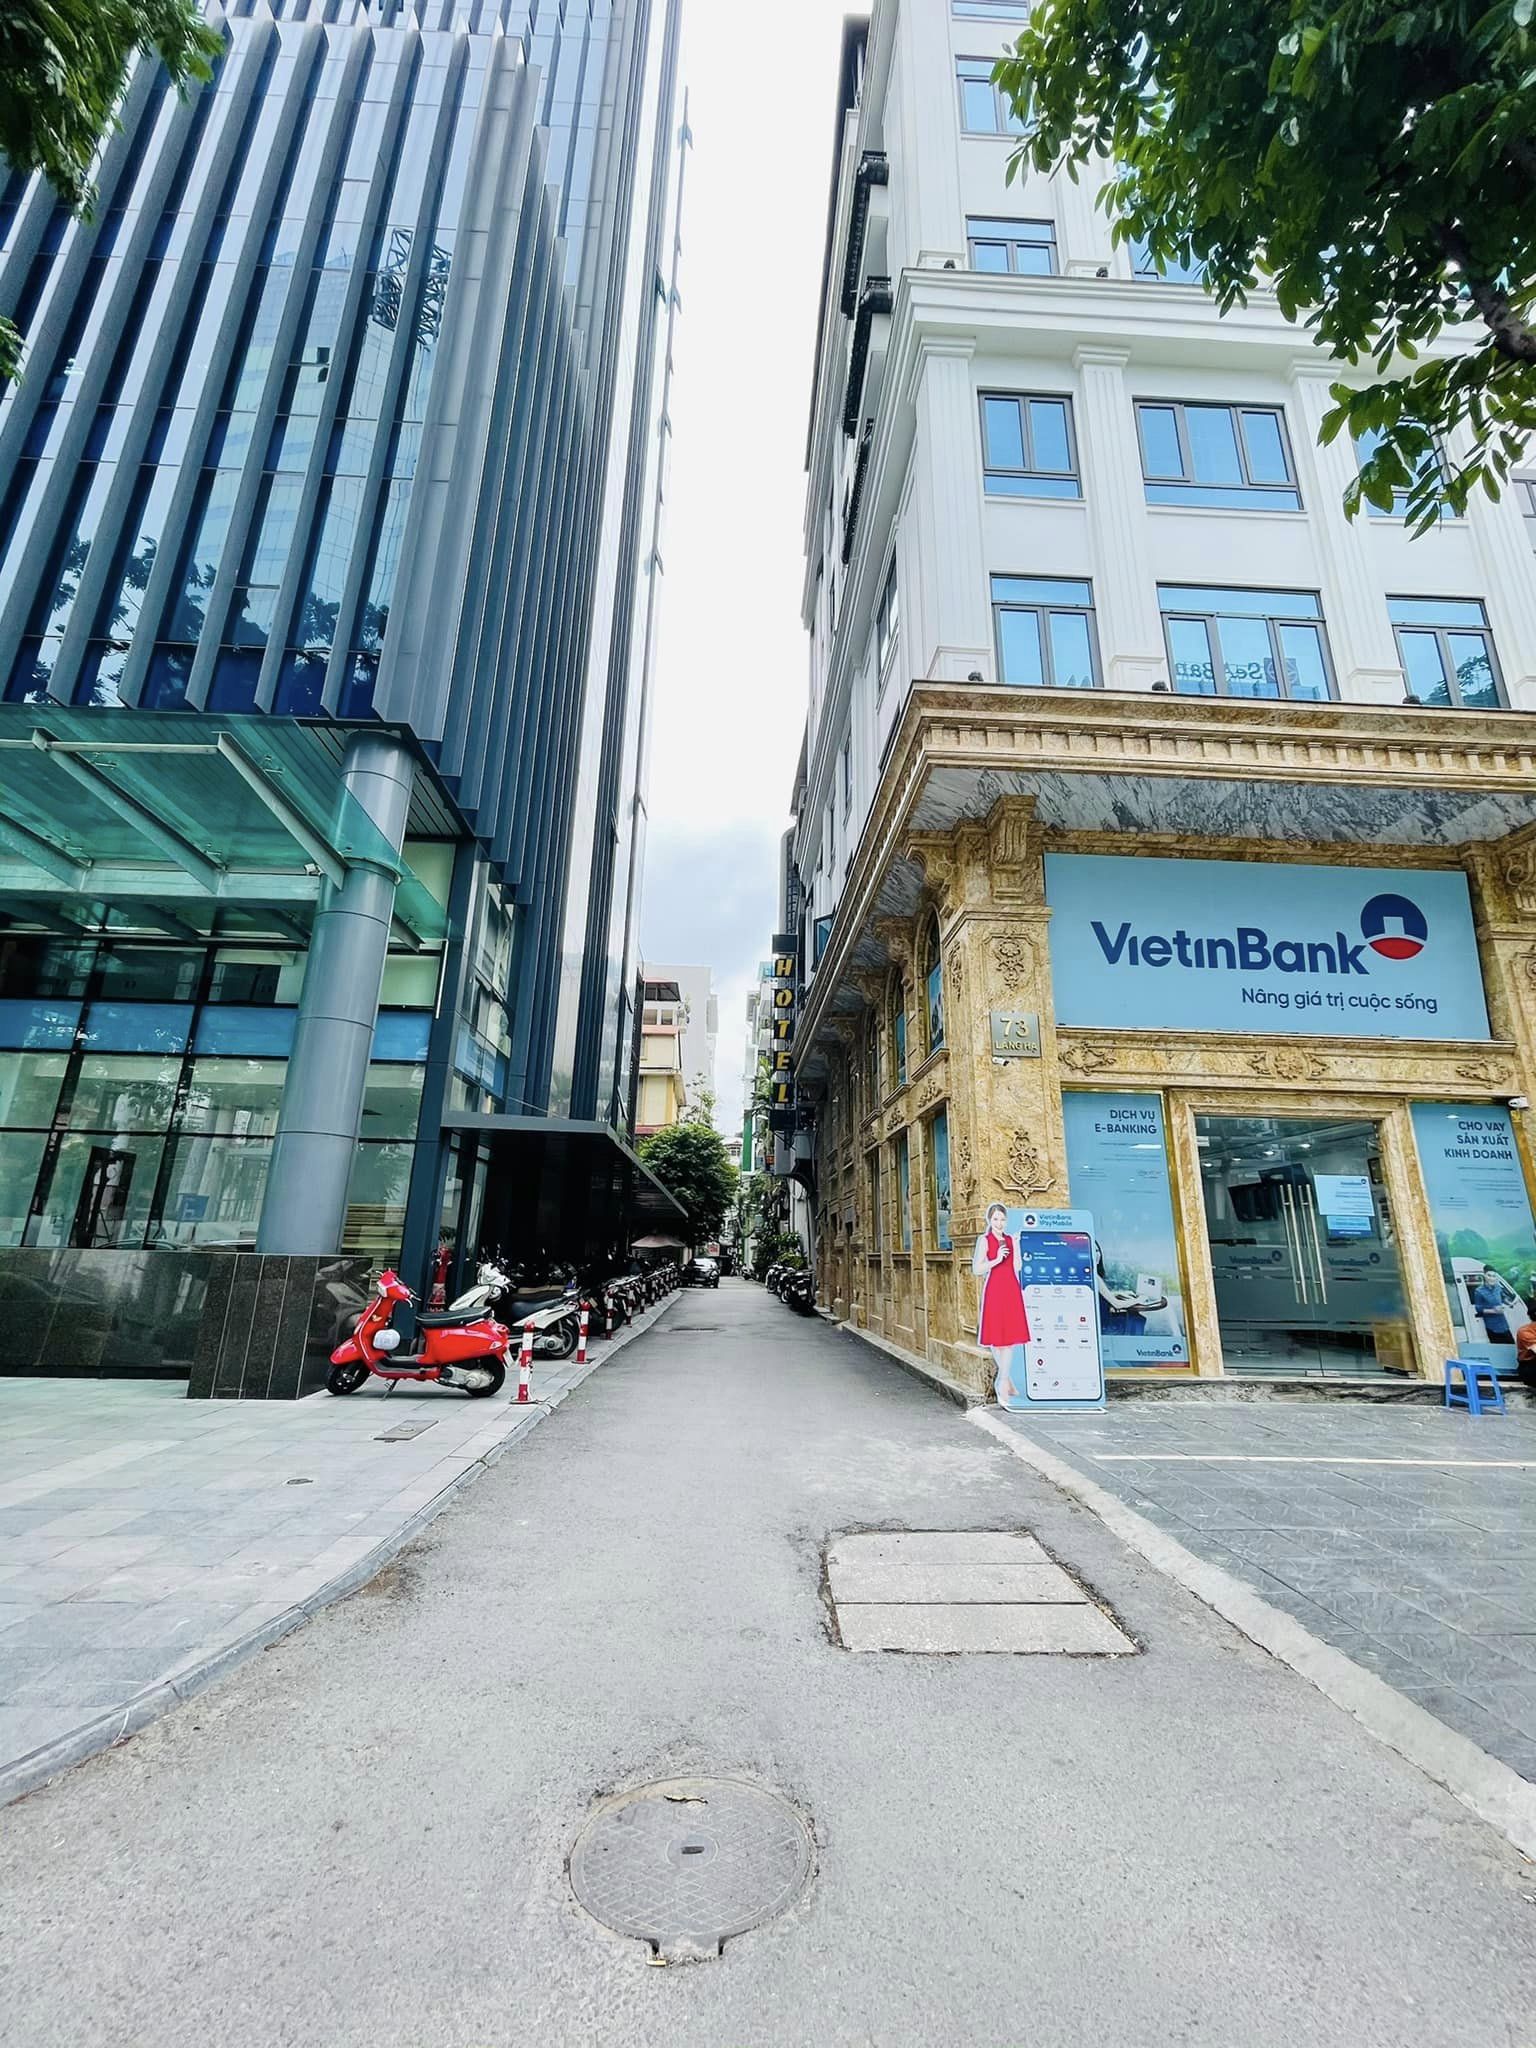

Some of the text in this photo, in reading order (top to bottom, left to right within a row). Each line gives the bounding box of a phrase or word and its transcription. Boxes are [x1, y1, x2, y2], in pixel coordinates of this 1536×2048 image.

[1090, 921, 1370, 975] VietinBank
[1242, 987, 1438, 1014] Nâng giá trị cuộc sống
[775, 958, 793, 1104] HOTEL
[999, 1017, 1029, 1038] 73
[1109, 1109, 1156, 1123] DỊCH VỤ
[1094, 1123, 1158, 1134] E-BANKING
[1458, 1121, 1505, 1132] CHO VAY
[1456, 1132, 1509, 1146] SẢN XUẤT
[1444, 1148, 1513, 1160] KINH DOANH
